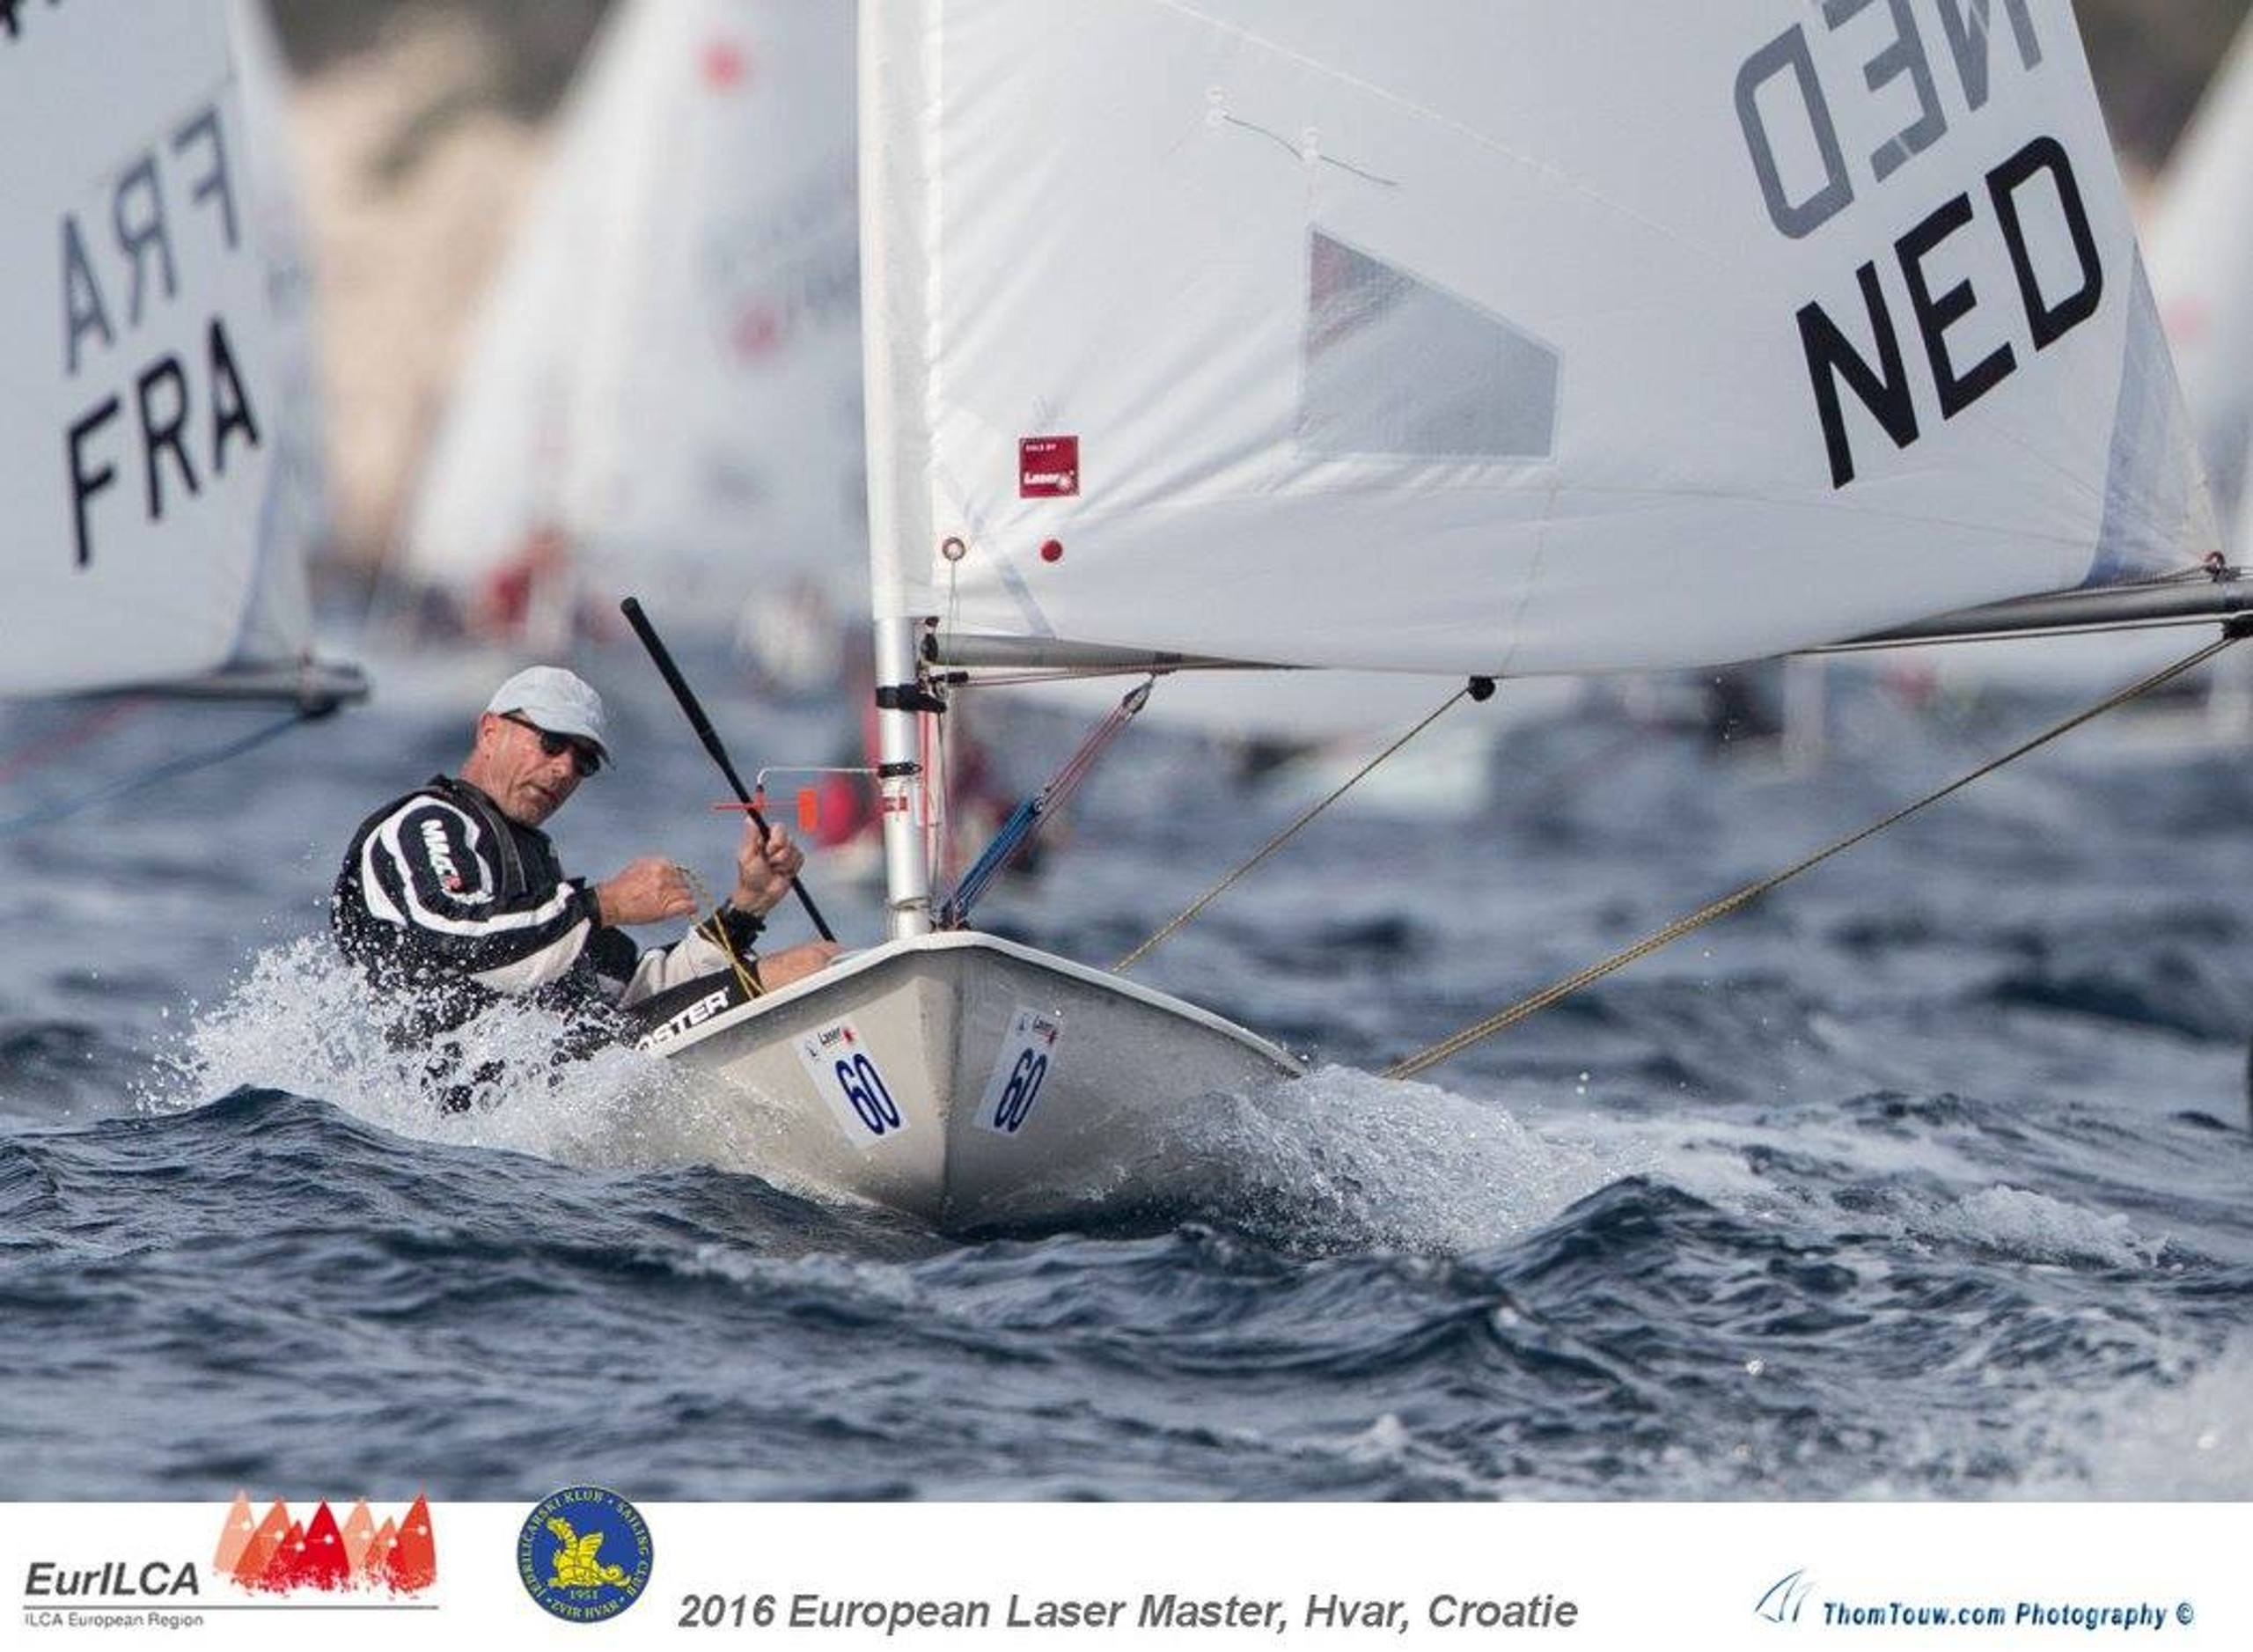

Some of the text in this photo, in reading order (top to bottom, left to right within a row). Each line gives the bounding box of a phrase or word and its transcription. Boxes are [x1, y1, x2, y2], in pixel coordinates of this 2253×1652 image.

[1795, 135, 2103, 490] NED
[66, 315, 261, 568] FRA
[835, 1054, 900, 1135] 60
[994, 1047, 1047, 1133] 60
